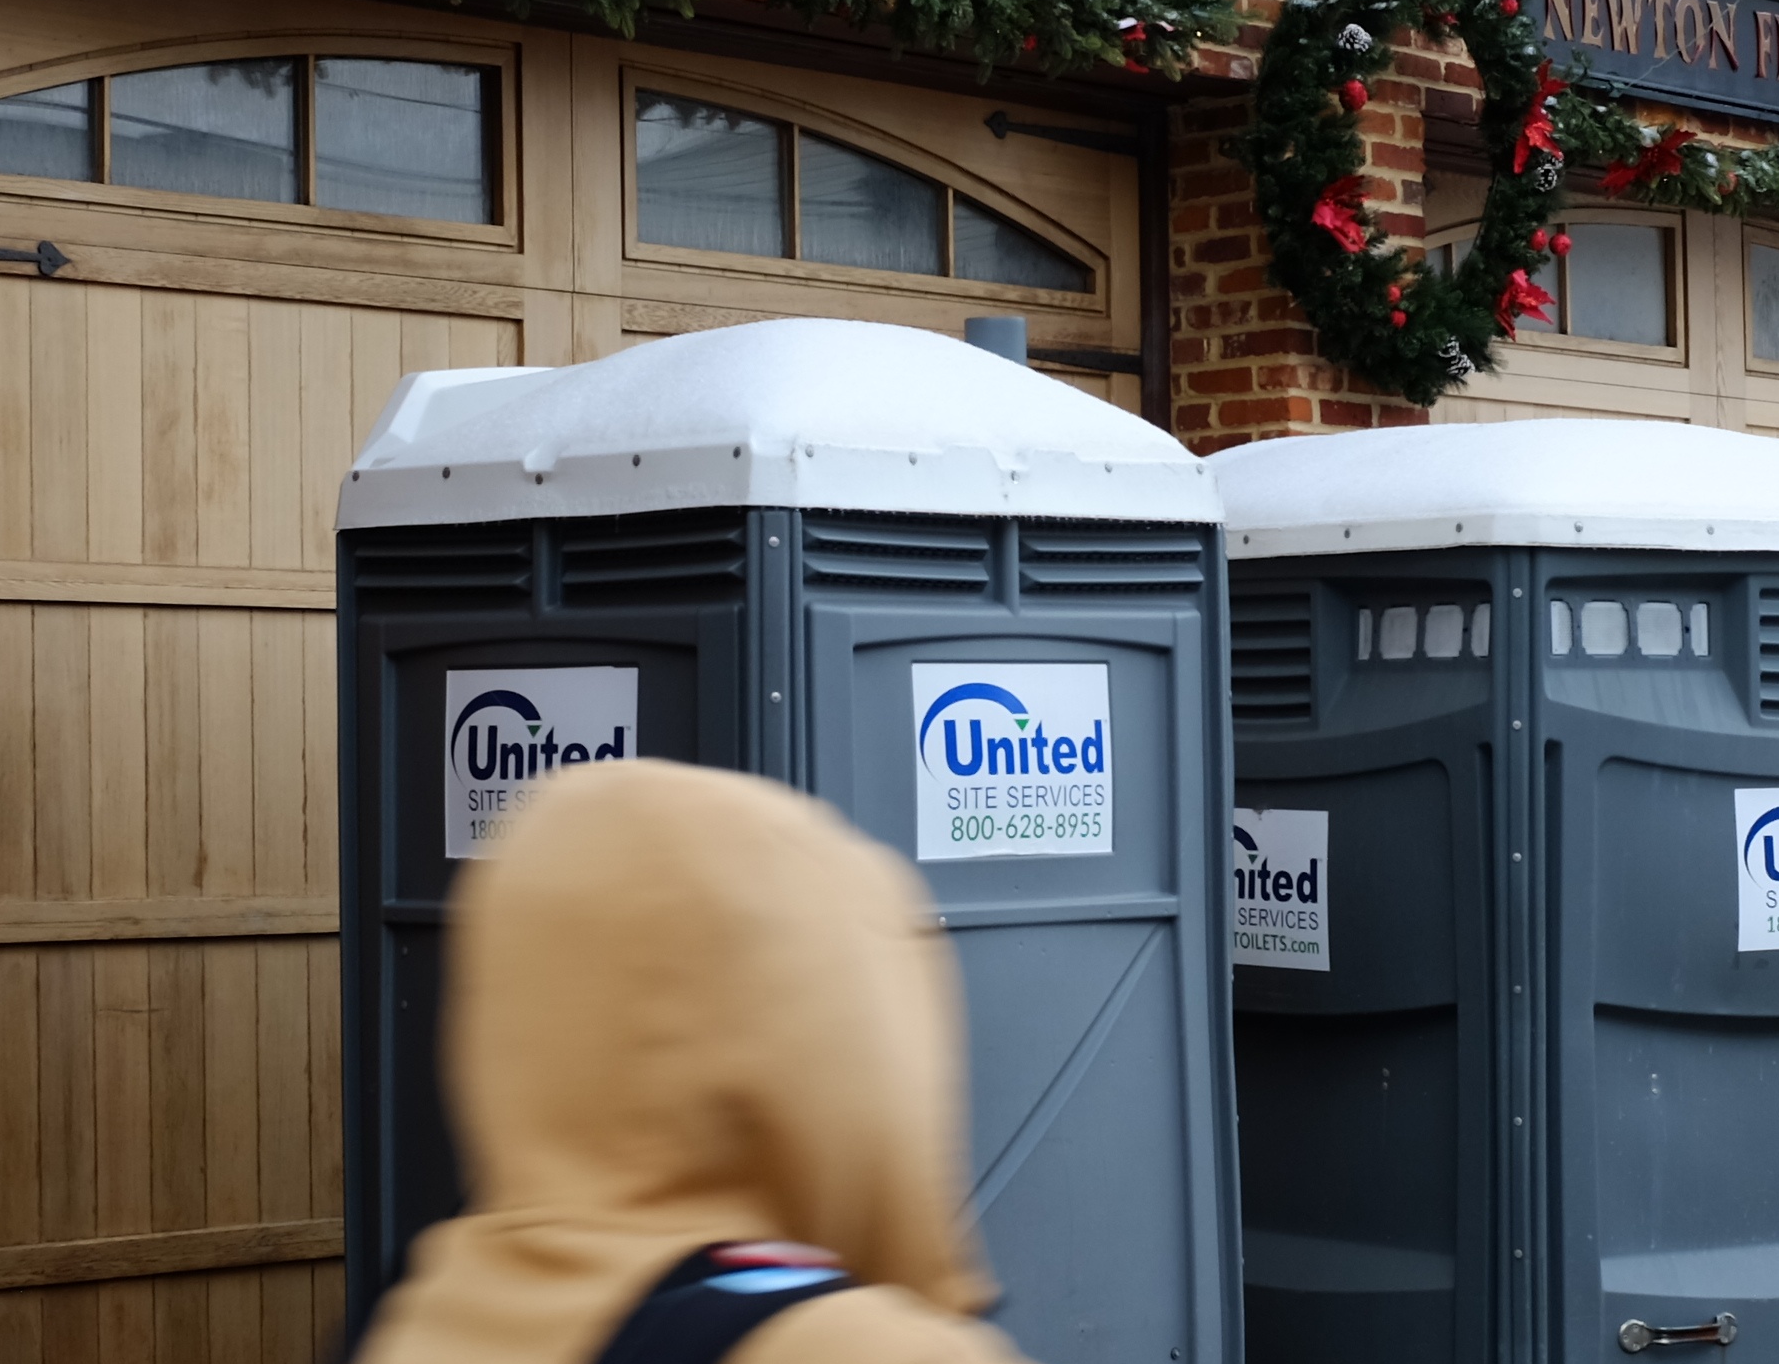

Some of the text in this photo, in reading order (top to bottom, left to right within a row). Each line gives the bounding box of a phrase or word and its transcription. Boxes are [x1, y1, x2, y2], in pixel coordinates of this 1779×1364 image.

[943, 718, 1105, 777] United
[468, 789, 507, 812] SITE
[947, 784, 1105, 810] SITE SERVICES
[950, 812, 1102, 842] 800-628-8955
[1234, 856, 1319, 904] nited
[1237, 907, 1319, 930] SERVICES
[1234, 931, 1320, 955] TOILETS.com
